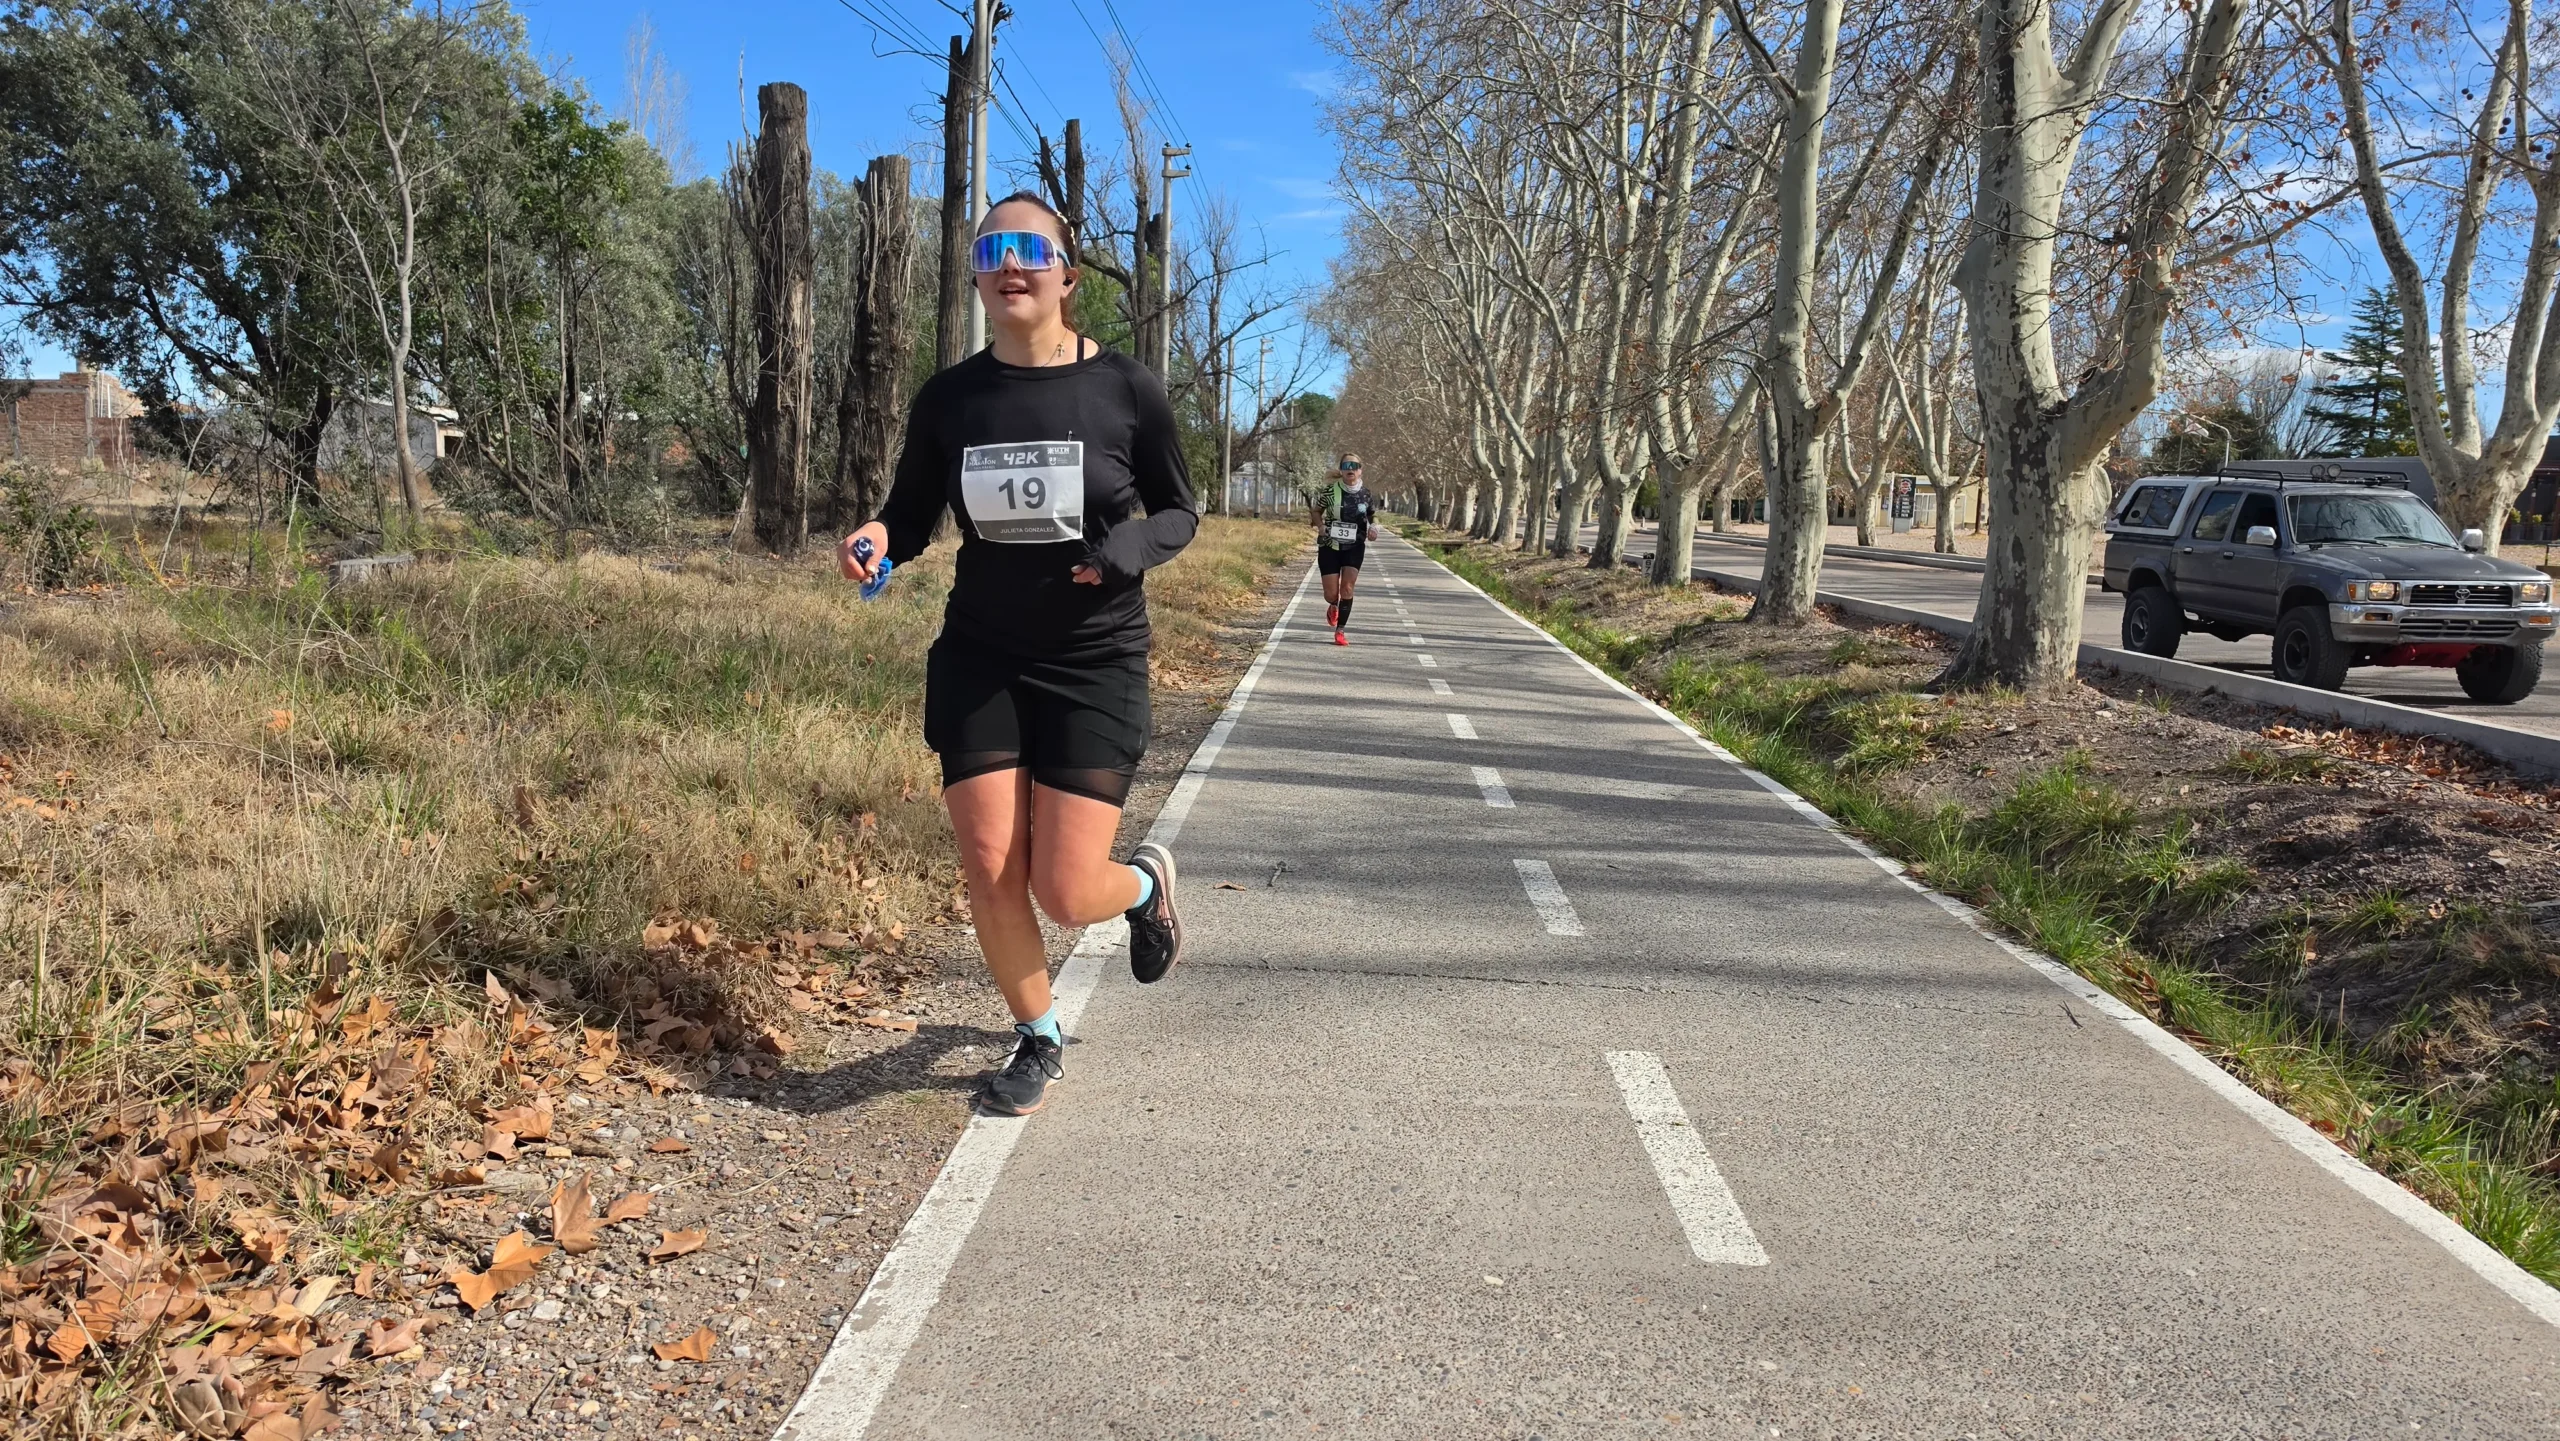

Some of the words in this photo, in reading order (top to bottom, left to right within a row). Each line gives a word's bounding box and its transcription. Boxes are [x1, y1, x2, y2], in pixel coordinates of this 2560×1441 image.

[1003, 451, 1039, 465] 42K
[998, 477, 1046, 509] 19
[1338, 529, 1349, 537] 33
